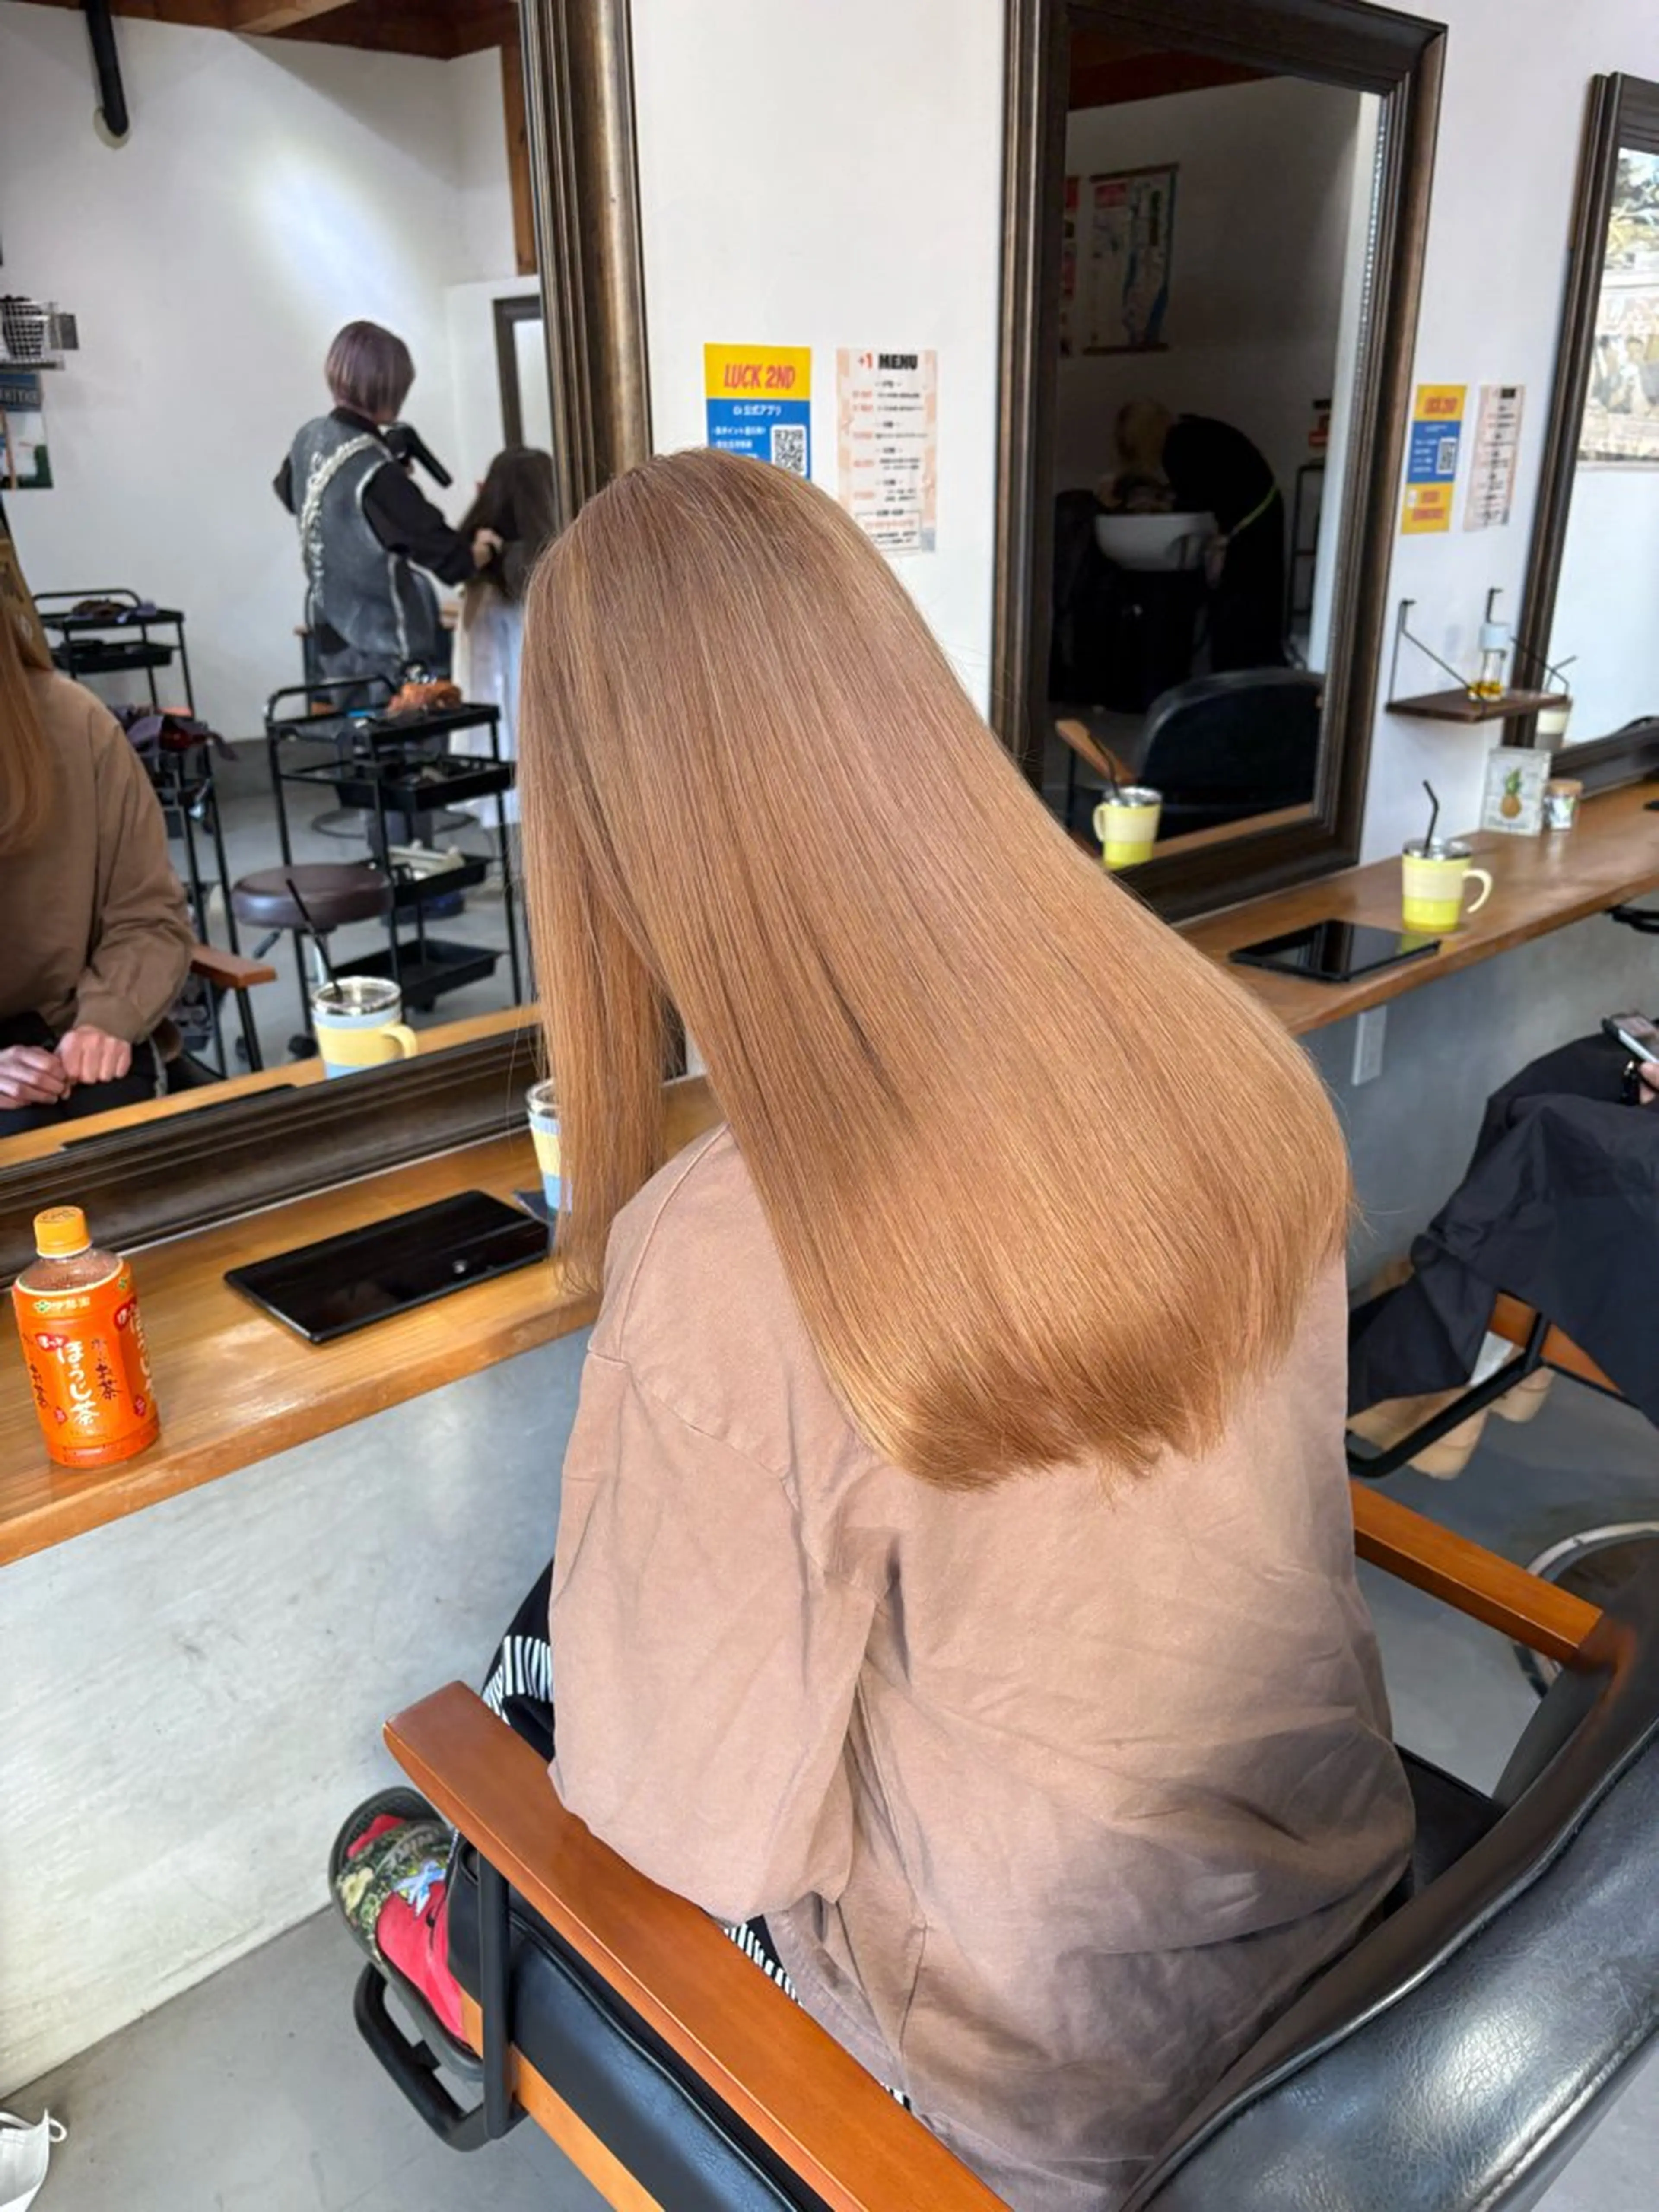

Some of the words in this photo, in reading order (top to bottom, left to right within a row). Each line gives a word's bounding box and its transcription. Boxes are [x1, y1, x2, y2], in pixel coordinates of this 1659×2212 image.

[878, 354, 918, 370] MENU
[723, 363, 763, 389] LUCK
[765, 364, 796, 390] 2ND
[56, 1341, 101, 1426] ほうじ茶
